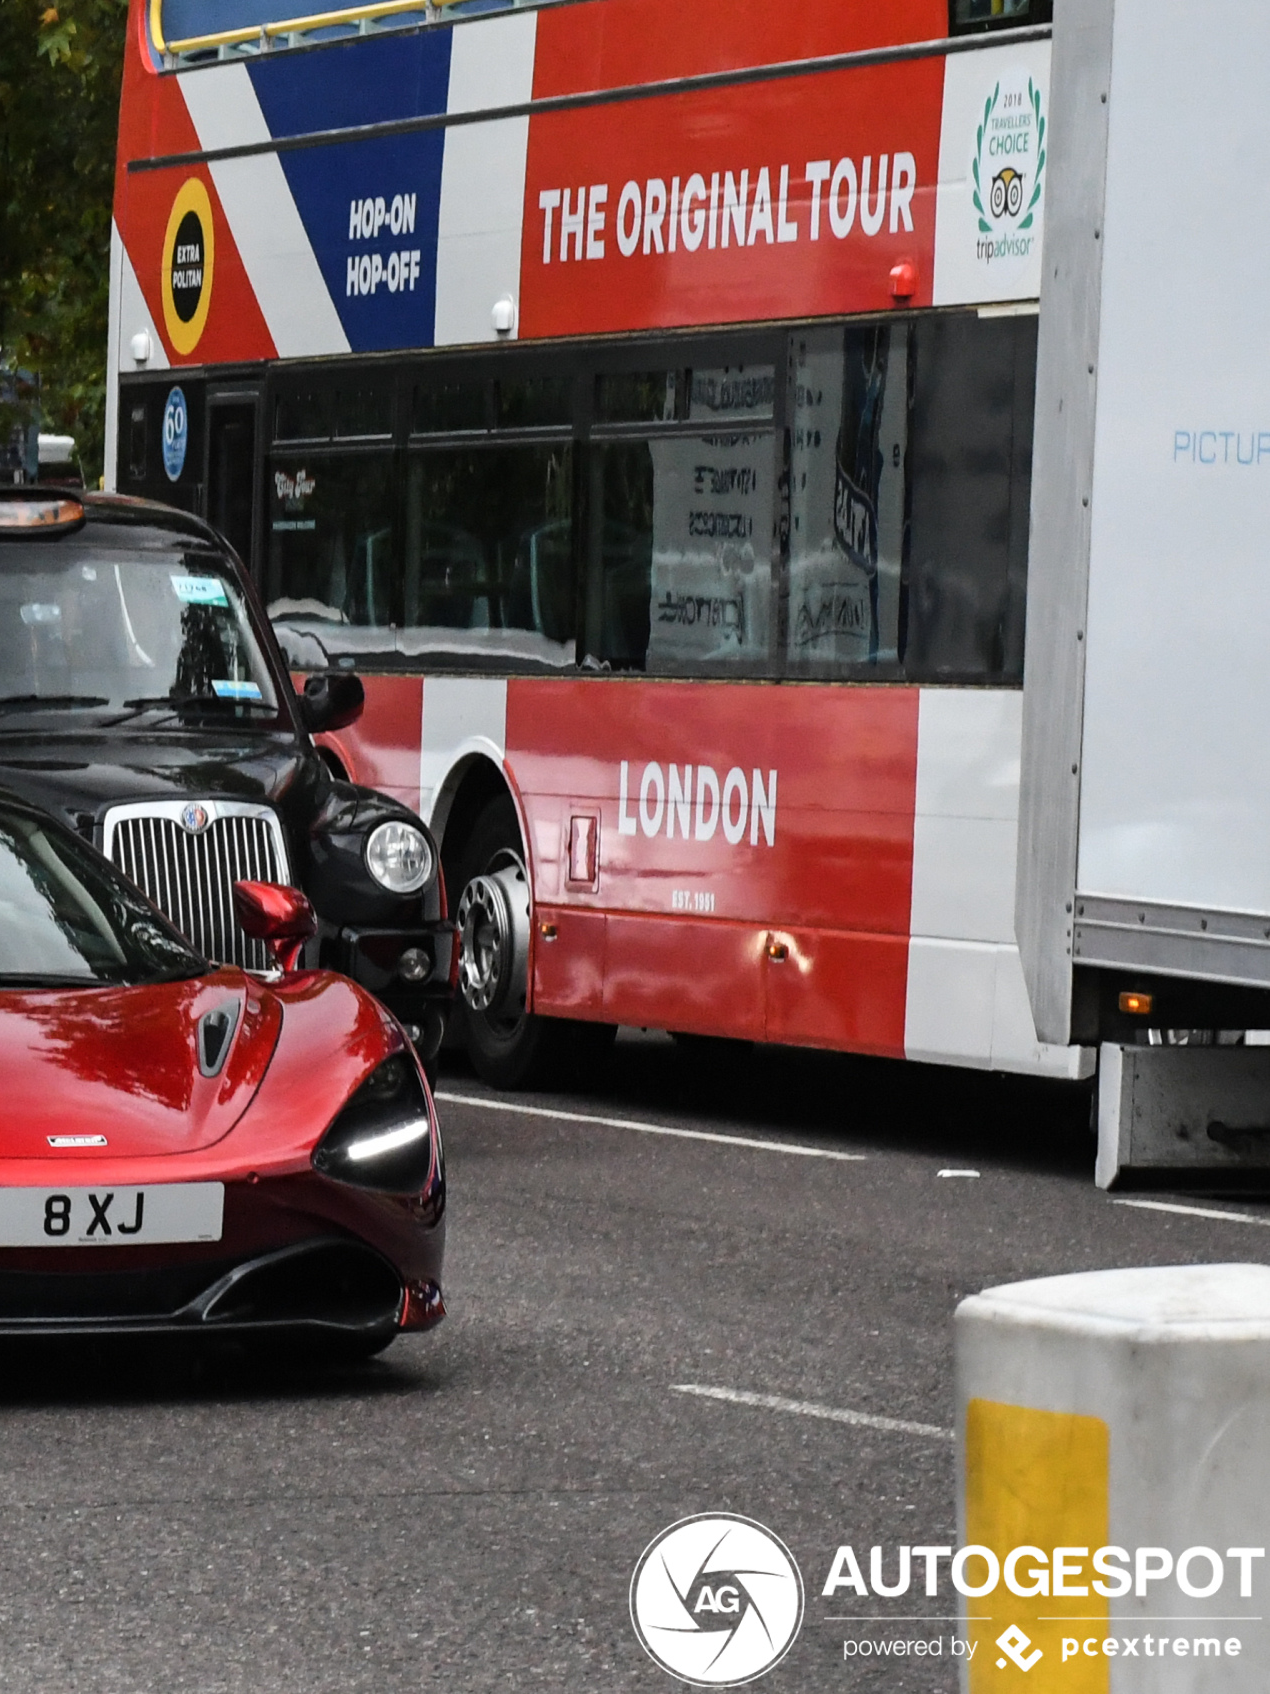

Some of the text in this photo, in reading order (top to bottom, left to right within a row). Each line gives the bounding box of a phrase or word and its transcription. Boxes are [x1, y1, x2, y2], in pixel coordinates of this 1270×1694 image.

[1003, 92, 1023, 108] 2018
[988, 132, 1030, 156] CHOICE
[348, 192, 417, 240] HOP-ON
[538, 151, 917, 265] THE ORIGINAL TOUR
[176, 243, 200, 265] EXTRA
[976, 231, 1032, 265] tripadvisor
[172, 268, 202, 289] POLITAN
[346, 249, 421, 297] HOP-OFF
[165, 404, 184, 446] 60
[617, 759, 778, 848] LONDON
[671, 889, 716, 912] EST. 1951
[43, 1191, 145, 1237] 8 XJ
